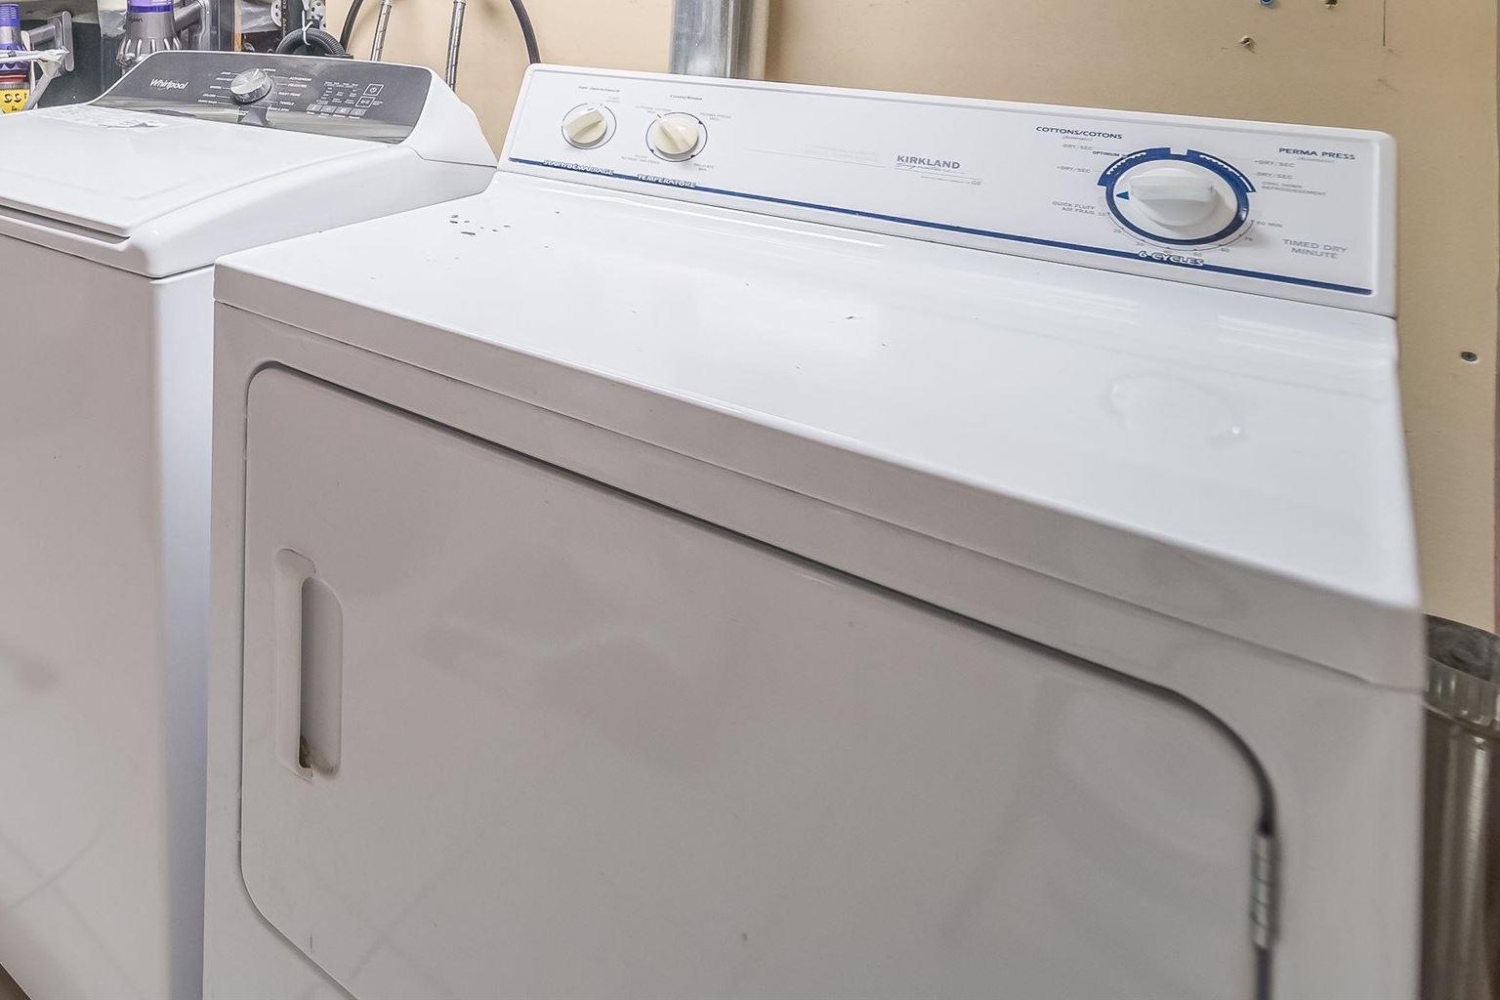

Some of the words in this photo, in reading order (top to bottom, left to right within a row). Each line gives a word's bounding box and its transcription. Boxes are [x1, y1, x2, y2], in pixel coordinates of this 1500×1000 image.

[149, 78, 189, 90] Whirlpool
[1036, 126, 1123, 140] COTTONS/COTONS
[1278, 147, 1318, 157] PERMA
[1321, 151, 1356, 160] PRESS
[896, 155, 961, 169] KIRKLAND
[1282, 239, 1319, 249] TIMED
[1323, 243, 1347, 253] DRY
[1150, 251, 1205, 267] CYCLES
